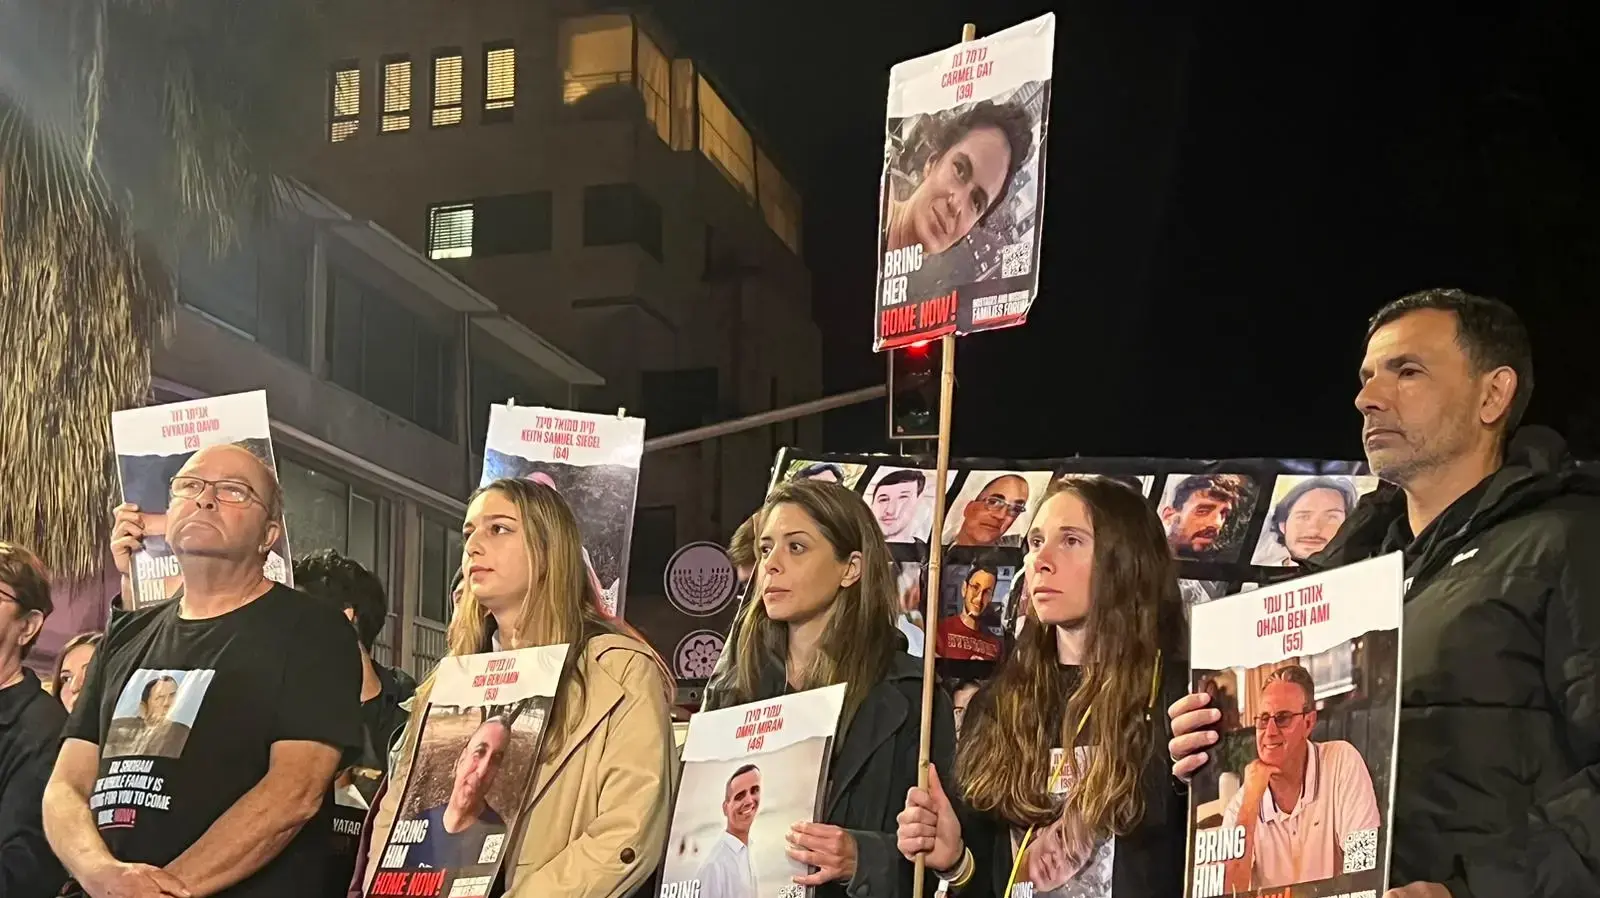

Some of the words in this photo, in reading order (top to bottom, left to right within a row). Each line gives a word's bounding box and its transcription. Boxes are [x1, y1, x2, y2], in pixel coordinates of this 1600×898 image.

[941, 66, 974, 88] CARMEL
[977, 61, 994, 78] GAT
[956, 82, 973, 102] (39)
[884, 243, 923, 278] BRING
[882, 276, 908, 306] HER
[881, 304, 918, 336] HOME
[920, 290, 957, 328] NOW!
[972, 303, 1003, 320] FAMILIES
[161, 423, 195, 438] EVYATAR
[196, 418, 220, 434] DAVID
[521, 429, 542, 443] KEITH
[543, 431, 574, 446] SAMUEL
[575, 434, 600, 449] SIEGEL
[184, 434, 200, 449] (23)
[553, 446, 570, 460] (64)
[136, 555, 179, 580] BRING
[139, 578, 166, 602] HIM
[1285, 591, 1295, 612] בן
[1297, 583, 1323, 606] אוהד
[1264, 594, 1282, 614] עמי
[1256, 615, 1284, 638] OHAD
[1287, 609, 1307, 631] BEN
[1310, 603, 1330, 625] AMI
[1282, 630, 1304, 654] (55)
[487, 671, 520, 686] BENJAMIN
[483, 687, 499, 702] (53)
[736, 723, 757, 739] OMRI
[757, 718, 783, 734] MIRAN
[125, 774, 154, 790] FAMILY
[152, 777, 164, 792] IS
[105, 791, 118, 805] FOR
[118, 790, 134, 805] YOU
[133, 791, 146, 805] TO
[145, 793, 172, 810] COME
[390, 819, 429, 844] BRING
[381, 844, 410, 869] HIM
[1195, 825, 1246, 865] BRING
[371, 872, 410, 895] HOME
[406, 868, 448, 896] NOW!
[1193, 862, 1225, 898] HIM
